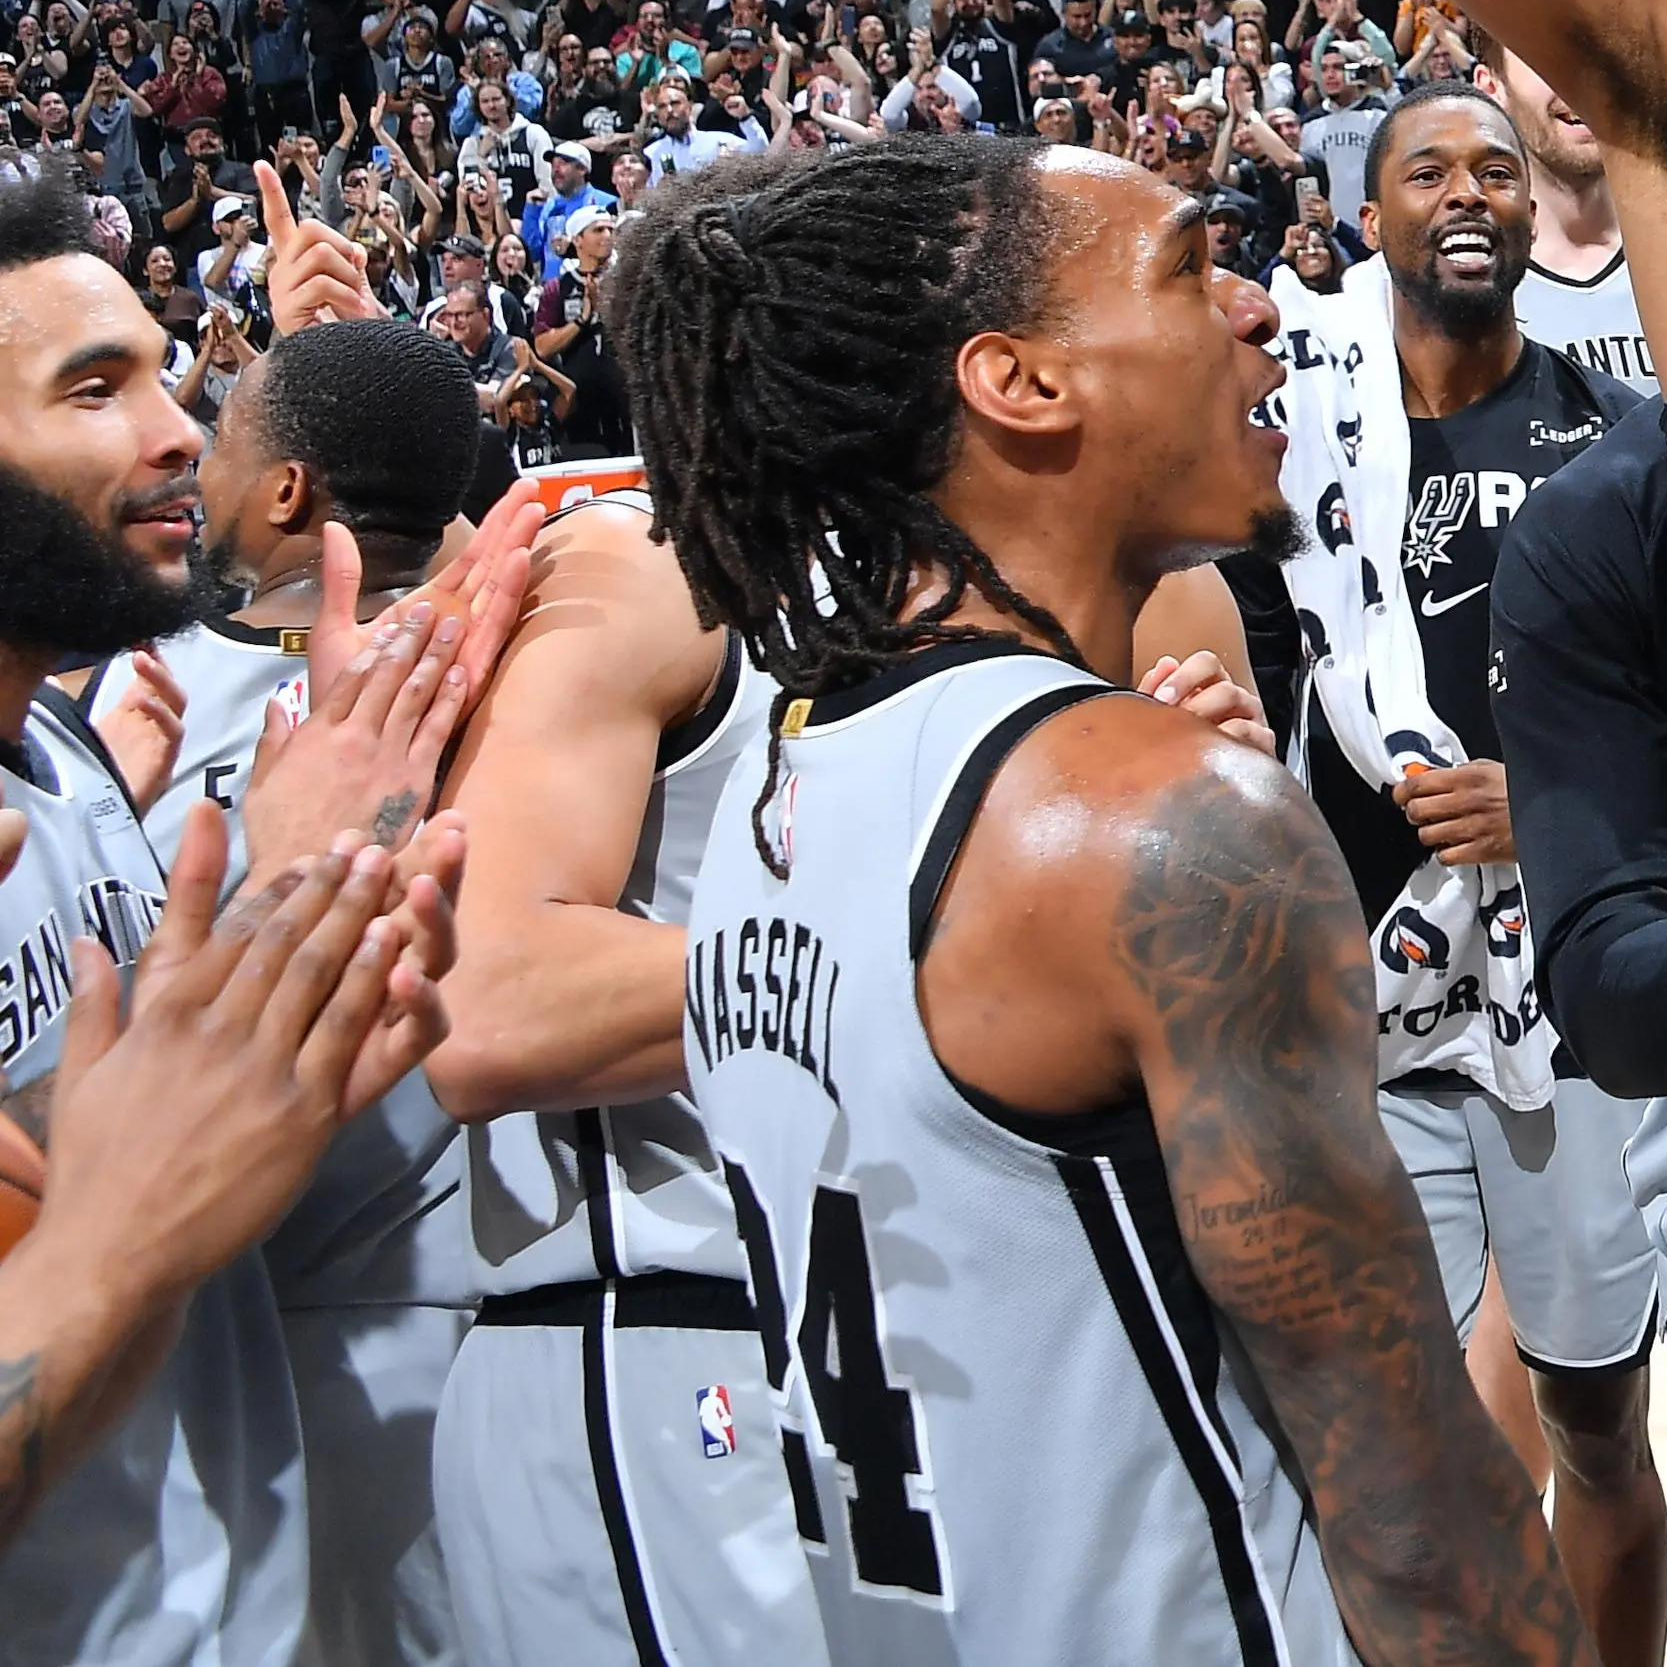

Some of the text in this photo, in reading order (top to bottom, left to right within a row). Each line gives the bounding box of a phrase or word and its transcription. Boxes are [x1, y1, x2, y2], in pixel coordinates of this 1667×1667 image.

[1540, 424, 1594, 444] LEDGER
[688, 917, 841, 1110] VASSELL
[722, 1152, 946, 1598] 4
